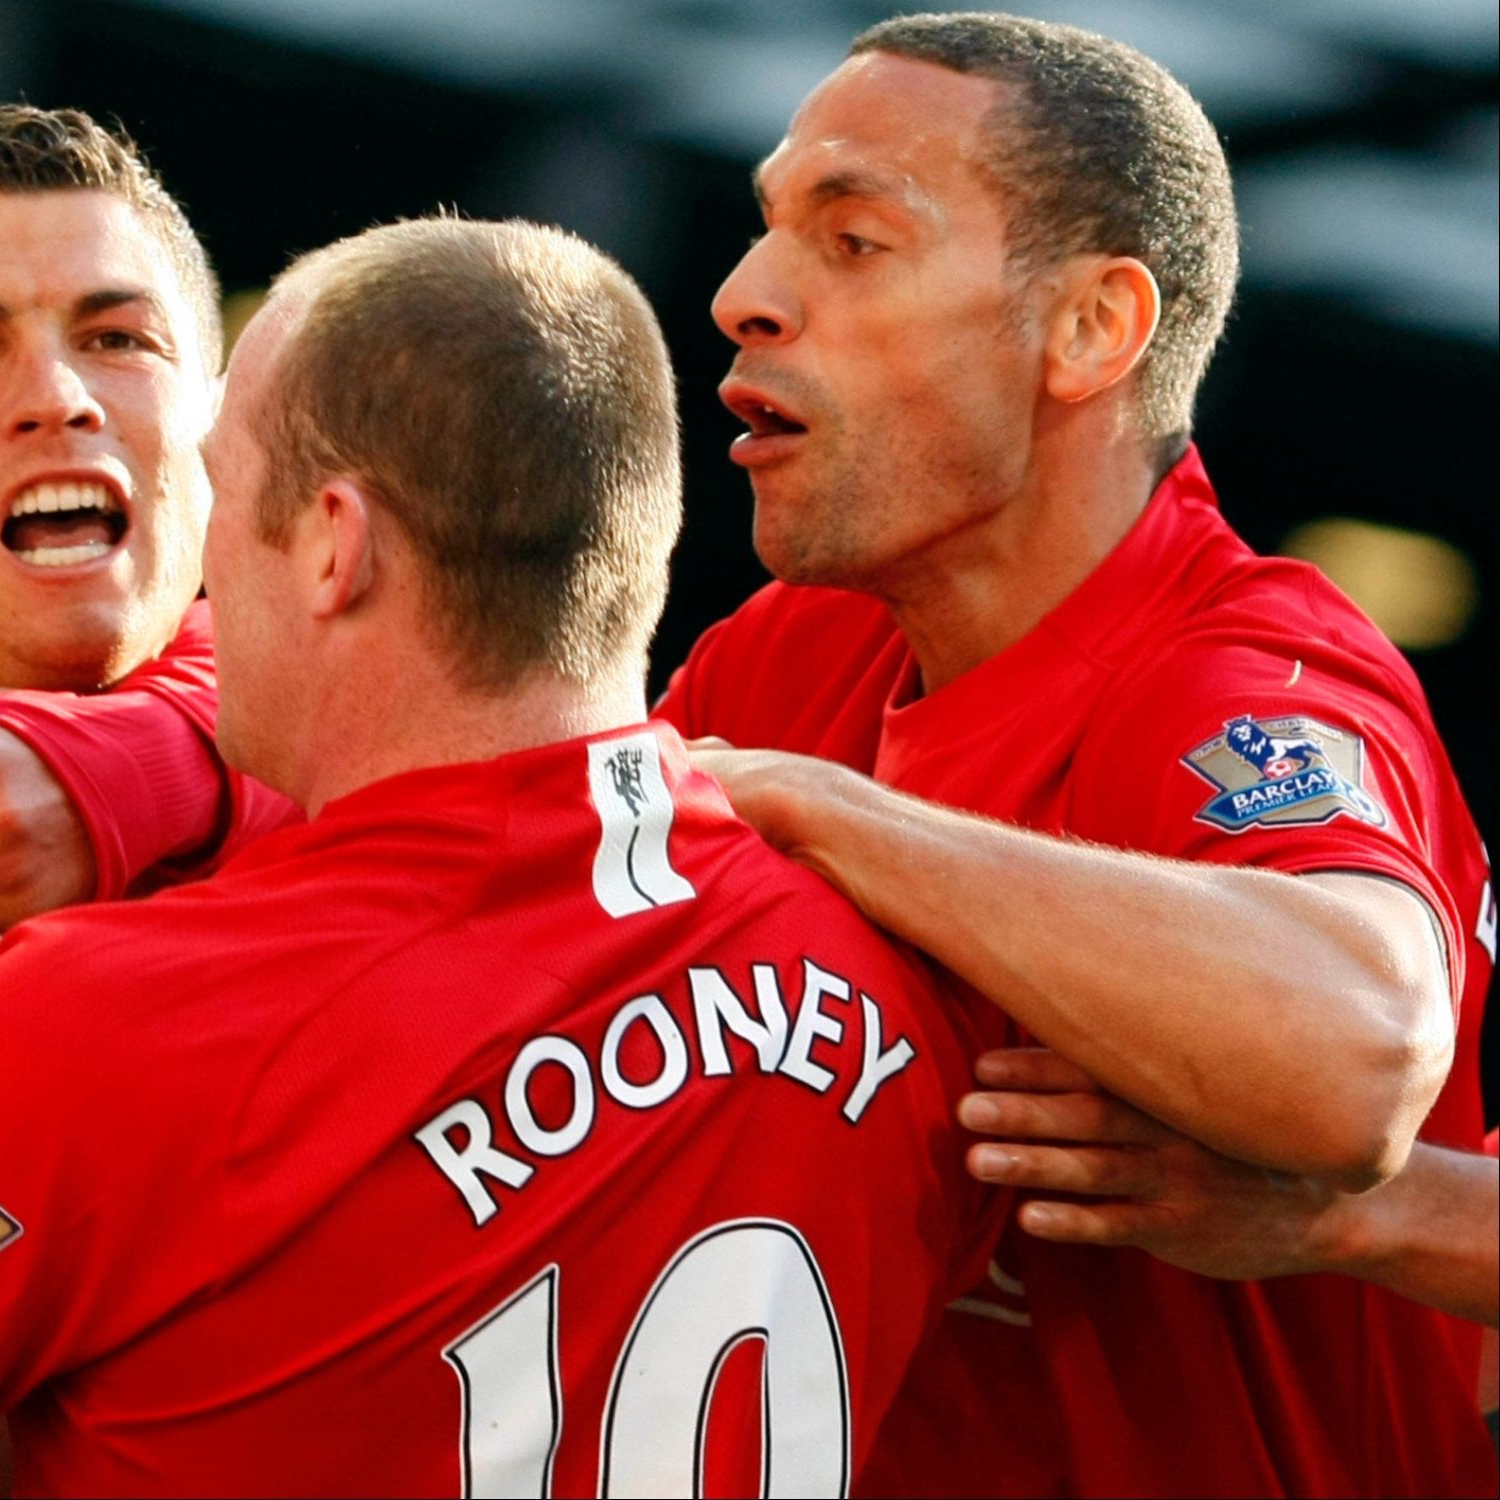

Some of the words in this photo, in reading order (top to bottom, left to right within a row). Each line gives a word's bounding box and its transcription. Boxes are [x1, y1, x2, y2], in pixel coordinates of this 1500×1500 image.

[1236, 794, 1297, 818] PREMIER
[414, 957, 916, 1229] ROONEY
[442, 1216, 851, 1498] 10
